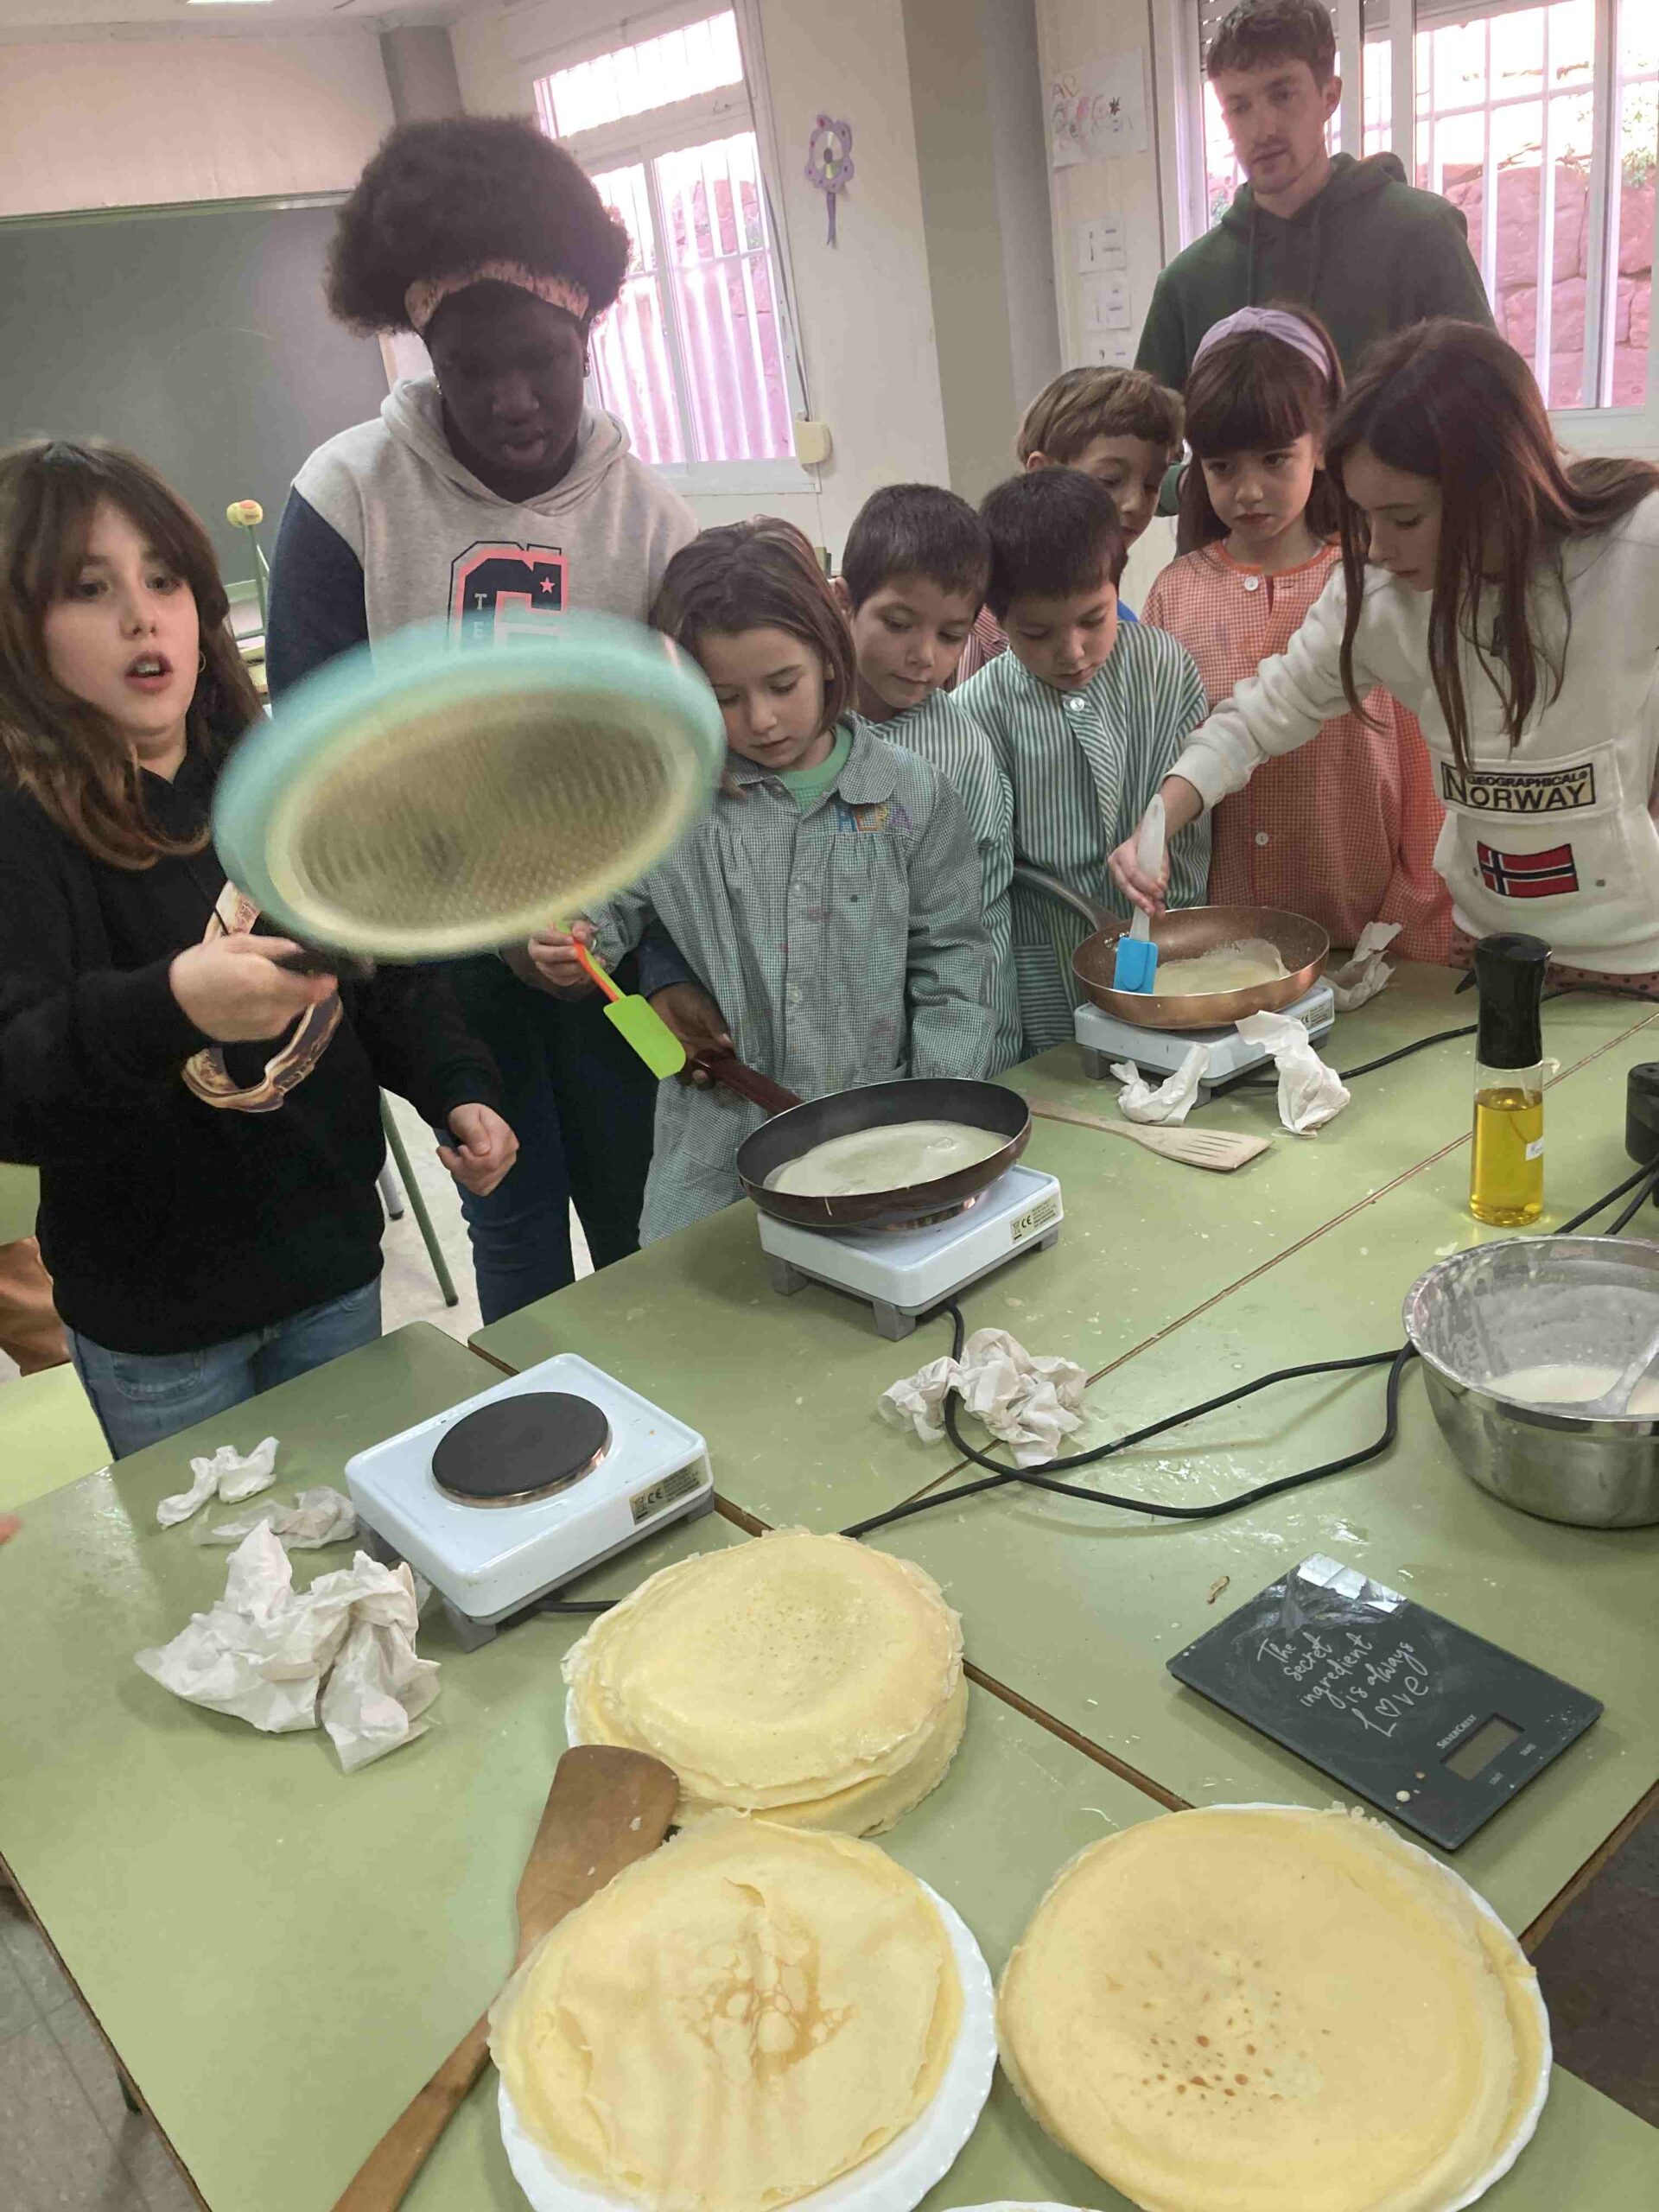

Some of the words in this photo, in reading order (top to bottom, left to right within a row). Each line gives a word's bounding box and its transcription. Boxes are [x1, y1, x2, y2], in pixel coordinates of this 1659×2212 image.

[1446, 766, 1586, 810] NORWAY
[1257, 1638, 1296, 1663] The
[1297, 1632, 1373, 1709] ingredient
[1342, 1686, 1368, 1703] is
[1365, 1641, 1428, 1685] always
